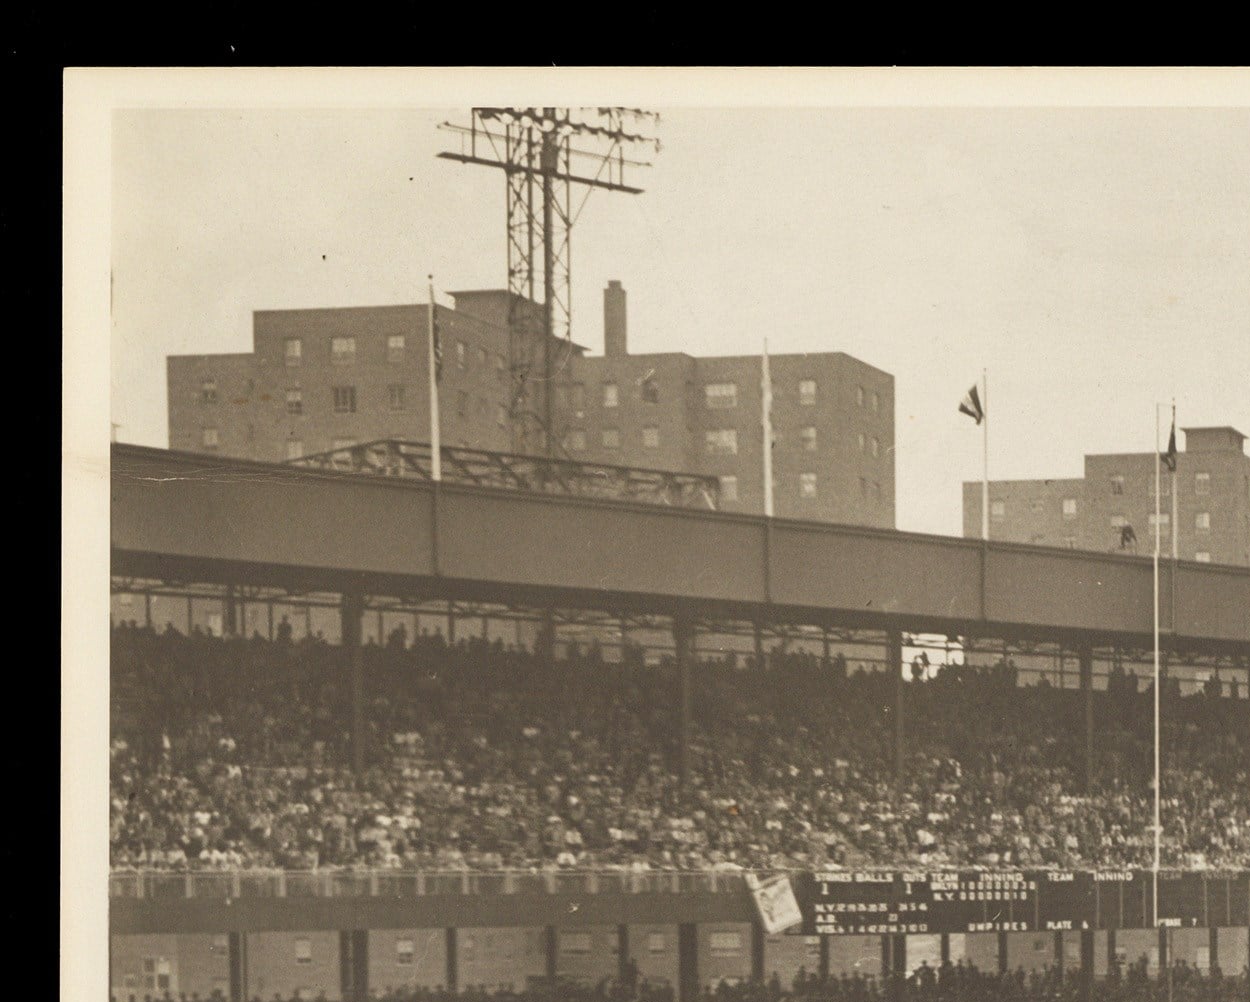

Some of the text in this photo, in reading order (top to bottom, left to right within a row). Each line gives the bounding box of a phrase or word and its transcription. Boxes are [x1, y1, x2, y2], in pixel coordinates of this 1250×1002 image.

[814, 872, 927, 882] STRIKES BALLS OUTS
[931, 872, 1024, 882] TEAM INNING
[1047, 872, 1134, 882] TEAM INNING
[821, 882, 830, 896] 1
[906, 882, 913, 895] 1
[968, 921, 1028, 932] UMPIRES
[1046, 920, 1073, 930] PLATE
